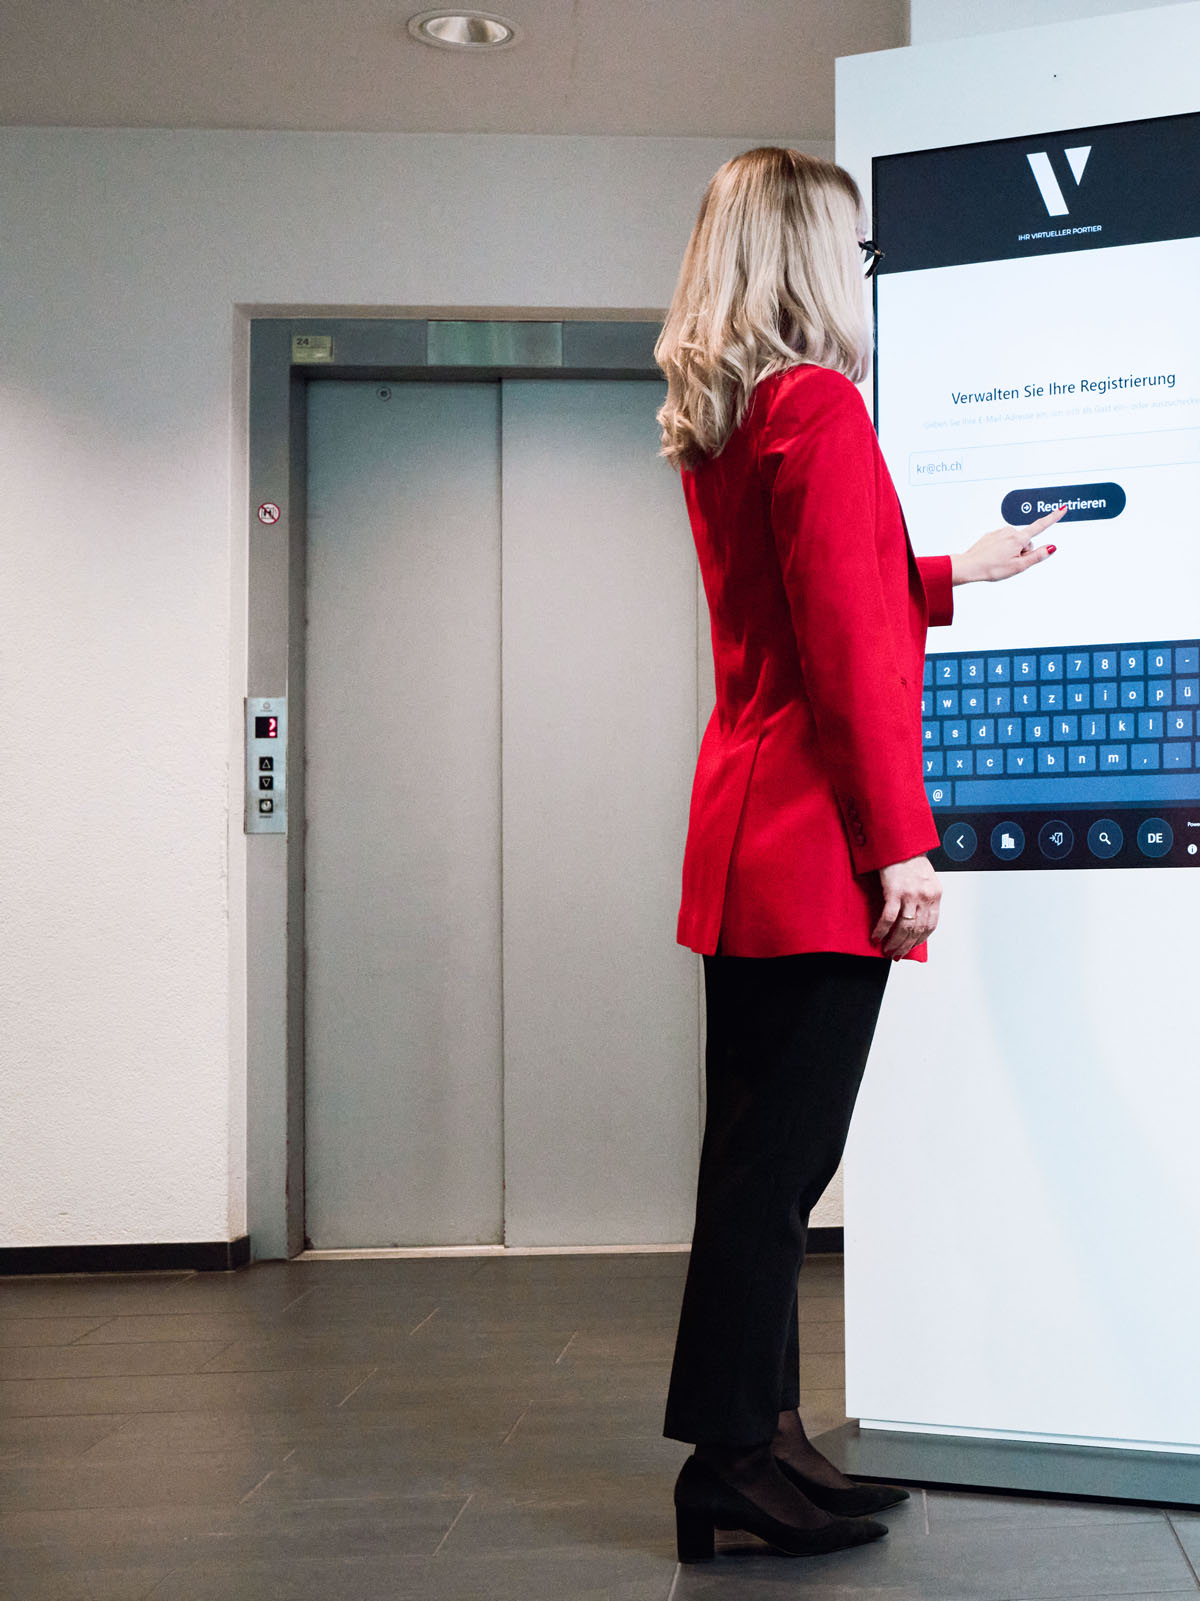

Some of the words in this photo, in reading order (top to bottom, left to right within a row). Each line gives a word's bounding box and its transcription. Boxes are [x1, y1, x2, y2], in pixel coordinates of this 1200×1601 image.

[1018, 233, 1031, 241] IHR
[1031, 228, 1072, 240] VIRTUELLER
[1072, 224, 1103, 235] PORTIER
[296, 337, 310, 346] 24
[951, 387, 1019, 405] Verwalten
[1023, 383, 1044, 398] Sie
[1049, 381, 1076, 396] Ihre
[1080, 373, 1176, 395] Registrierung
[916, 460, 962, 475] kr@ch.ch
[943, 666, 951, 678] 2
[969, 665, 977, 677] 3
[995, 664, 1003, 675] 4
[1021, 662, 1029, 674] 5
[1047, 661, 1056, 673] 6
[1074, 660, 1082, 671] 7
[1101, 658, 1109, 670] 8
[1128, 657, 1136, 669] 9
[1155, 655, 1164, 667] 0
[942, 699, 952, 708] w
[969, 698, 977, 707] e
[996, 697, 1002, 706] r
[1048, 694, 1056, 703] z
[1075, 693, 1082, 702] u
[1128, 691, 1137, 700] o
[1156, 689, 1164, 701] p
[1184, 686, 1192, 697] ü
[925, 730, 932, 739] a
[952, 729, 959, 738] s
[978, 725, 986, 737] d
[1033, 726, 1041, 738] g
[1062, 722, 1069, 734] h
[1118, 720, 1126, 732] k
[1175, 718, 1184, 729] ö
[926, 760, 933, 772] y
[956, 759, 963, 769] x
[986, 758, 994, 767] c
[1016, 757, 1024, 766] v
[1047, 754, 1055, 765] b
[1078, 755, 1086, 764] n
[1108, 754, 1119, 763] m
[932, 789, 944, 802] @
[1147, 832, 1164, 844] DE
